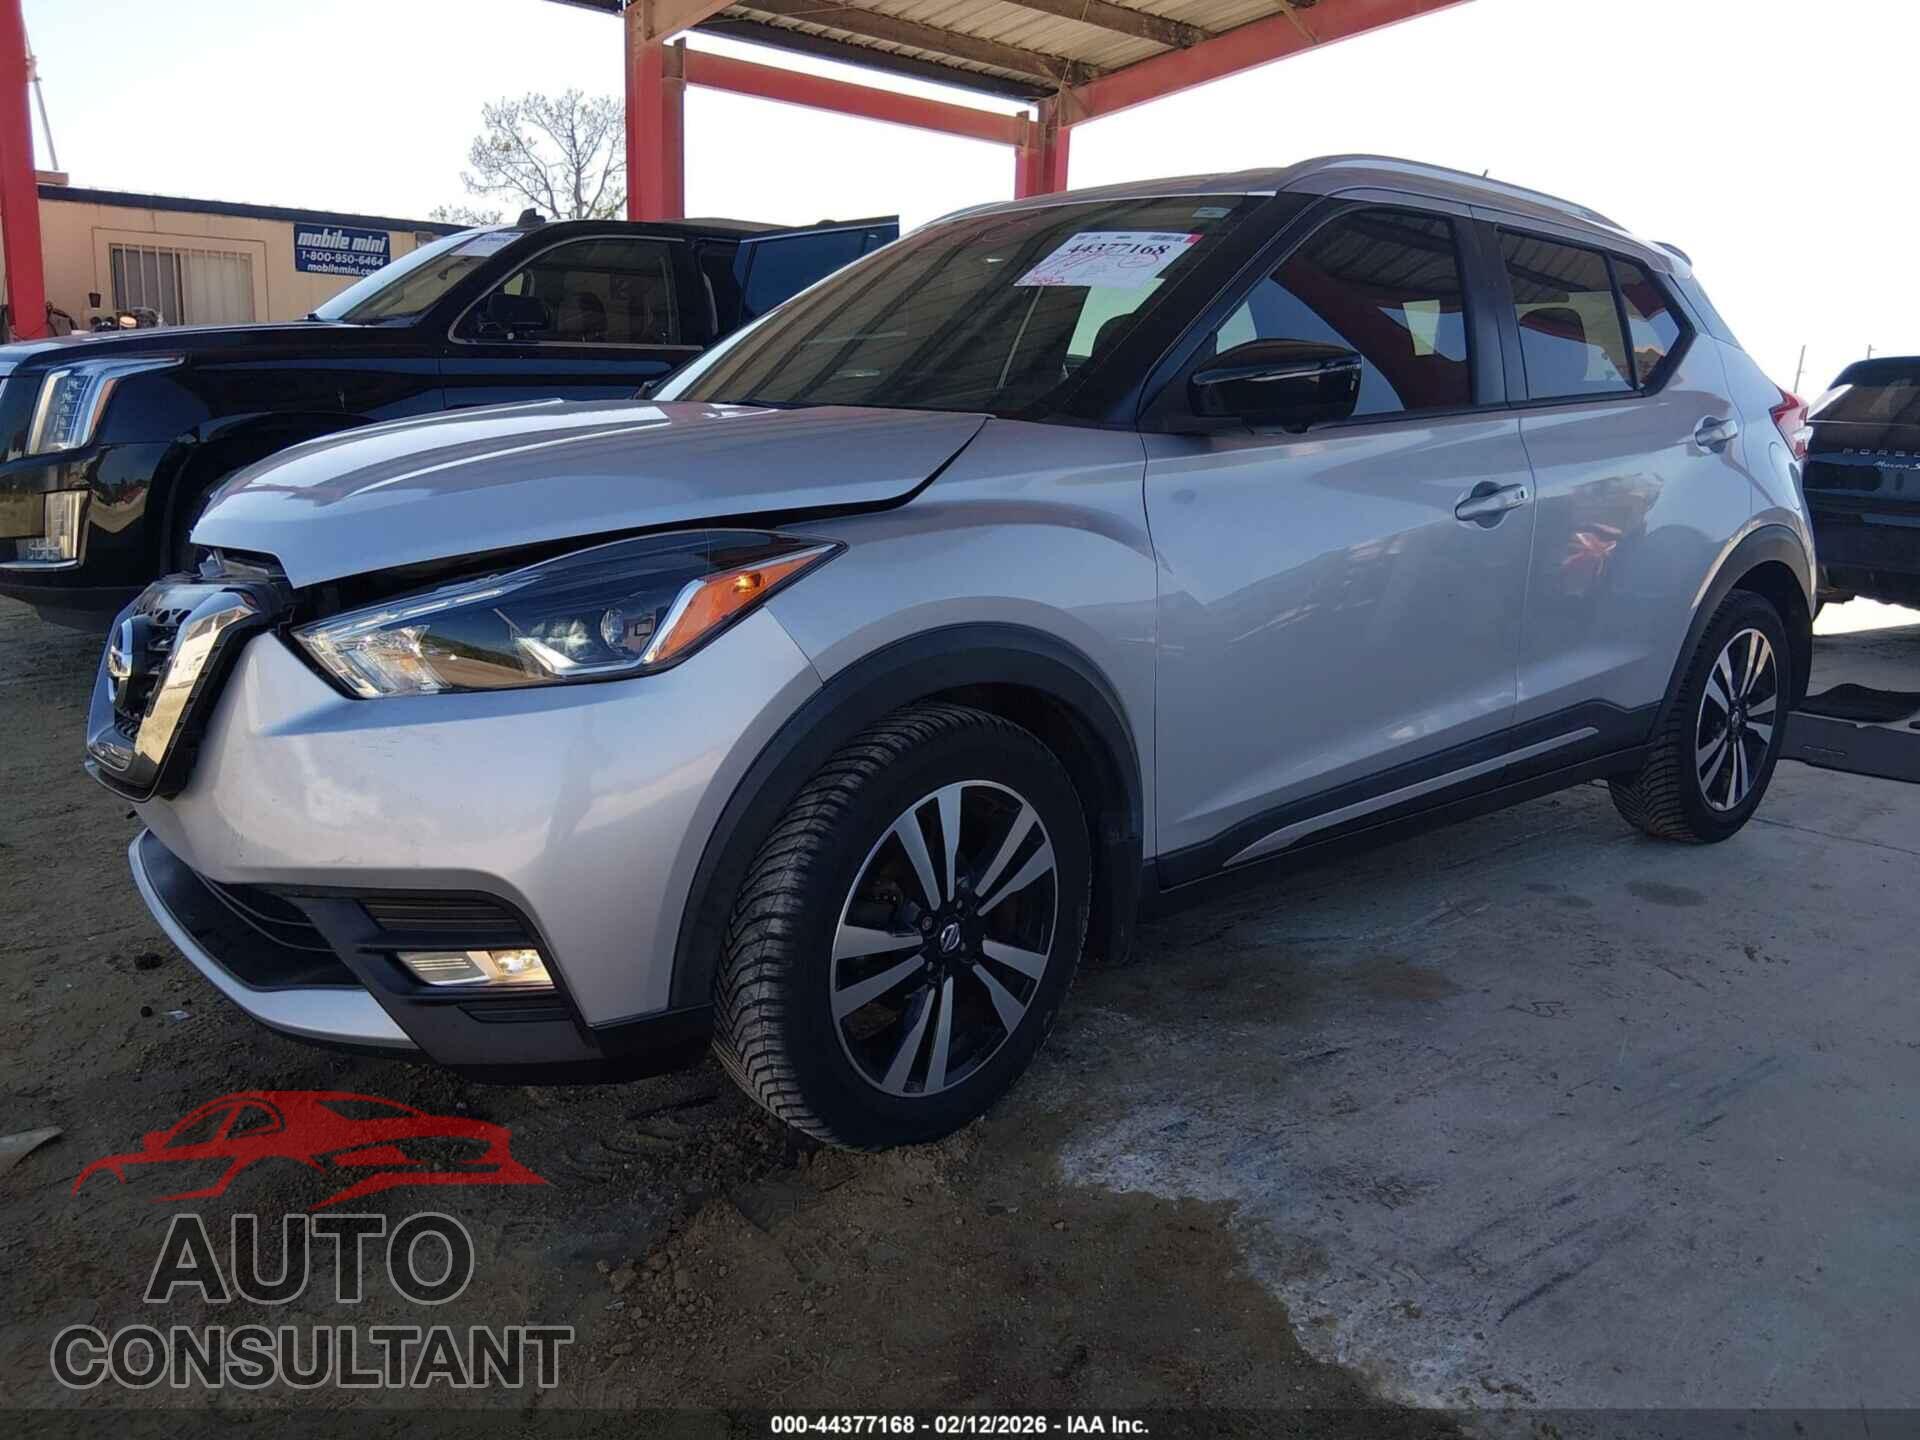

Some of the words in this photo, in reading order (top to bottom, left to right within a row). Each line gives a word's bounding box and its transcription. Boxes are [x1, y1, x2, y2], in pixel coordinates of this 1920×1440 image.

[298, 228, 350, 249] mobile
[352, 235, 388, 253] mini
[1068, 243, 1171, 256] 44377168
[302, 250, 384, 266] 1-800-950-6464
